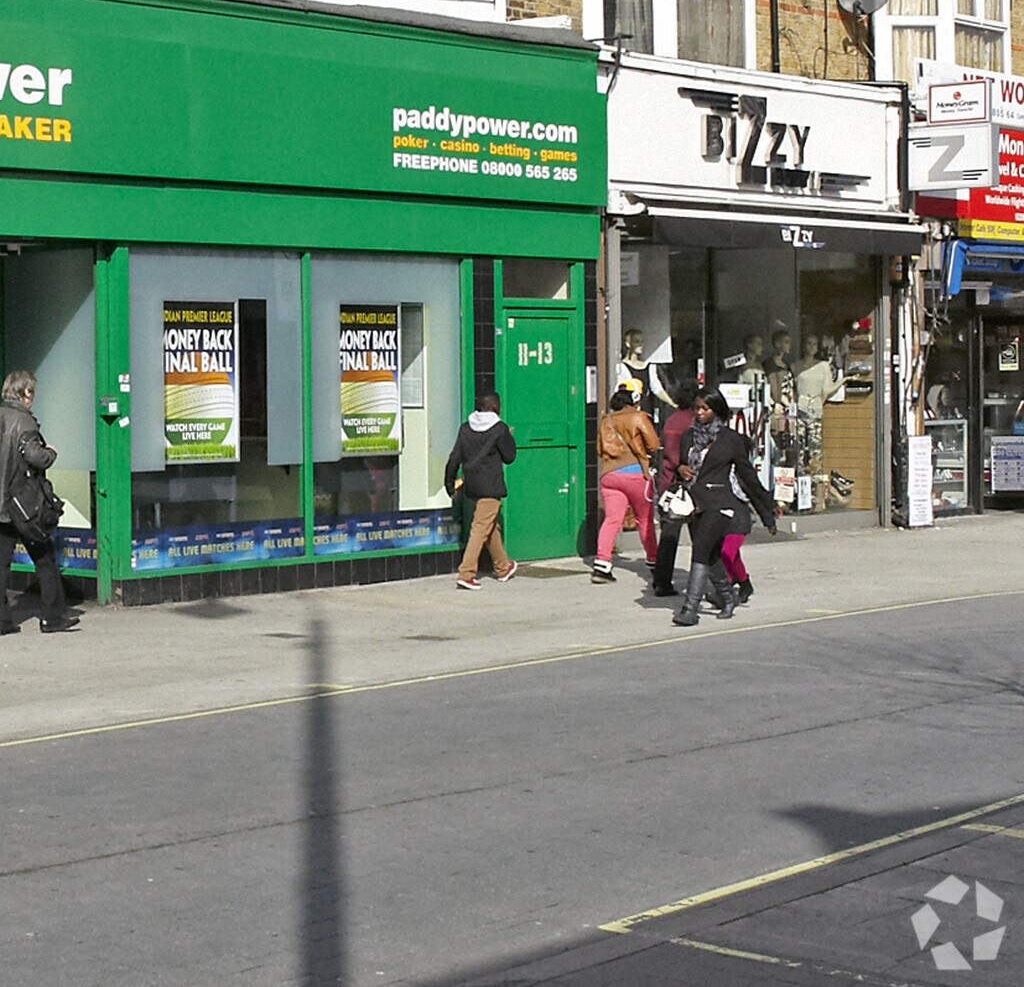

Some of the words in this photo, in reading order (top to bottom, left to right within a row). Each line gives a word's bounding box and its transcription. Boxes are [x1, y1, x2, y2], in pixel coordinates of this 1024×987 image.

[393, 106, 578, 144] paddypower.com
[393, 134, 429, 149] poker
[440, 139, 480, 153] casino
[490, 142, 531, 160] betting
[540, 148, 578, 162] games
[700, 94, 811, 187] BIZZY
[393, 153, 478, 174] FREEPHONE
[481, 161, 523, 178] 08000
[526, 164, 550, 180] 565
[553, 167, 578, 182] 265
[164, 311, 181, 323] DIAN
[182, 311, 208, 323] PREMIER
[209, 311, 232, 323] LEAGUE
[339, 312, 355, 324] DIAN
[202, 329, 232, 351] BACK
[339, 330, 372, 350] MONEY
[372, 330, 397, 350] BACK
[165, 352, 198, 373] INAL
[201, 352, 233, 373] BALL
[339, 351, 368, 371] FINAL
[371, 351, 397, 371] BALL
[518, 342, 553, 366] 11-13
[166, 423, 188, 432] WATCH
[189, 423, 208, 432] EVERY
[209, 422, 226, 431] GAME
[182, 432, 196, 440] LIVE
[196, 431, 212, 440] HERE
[168, 547, 181, 557] ALL
[183, 545, 199, 556] LIVE
[200, 542, 235, 554] MATCHES
[263, 539, 276, 549] ALL
[277, 538, 292, 548] LIVE
